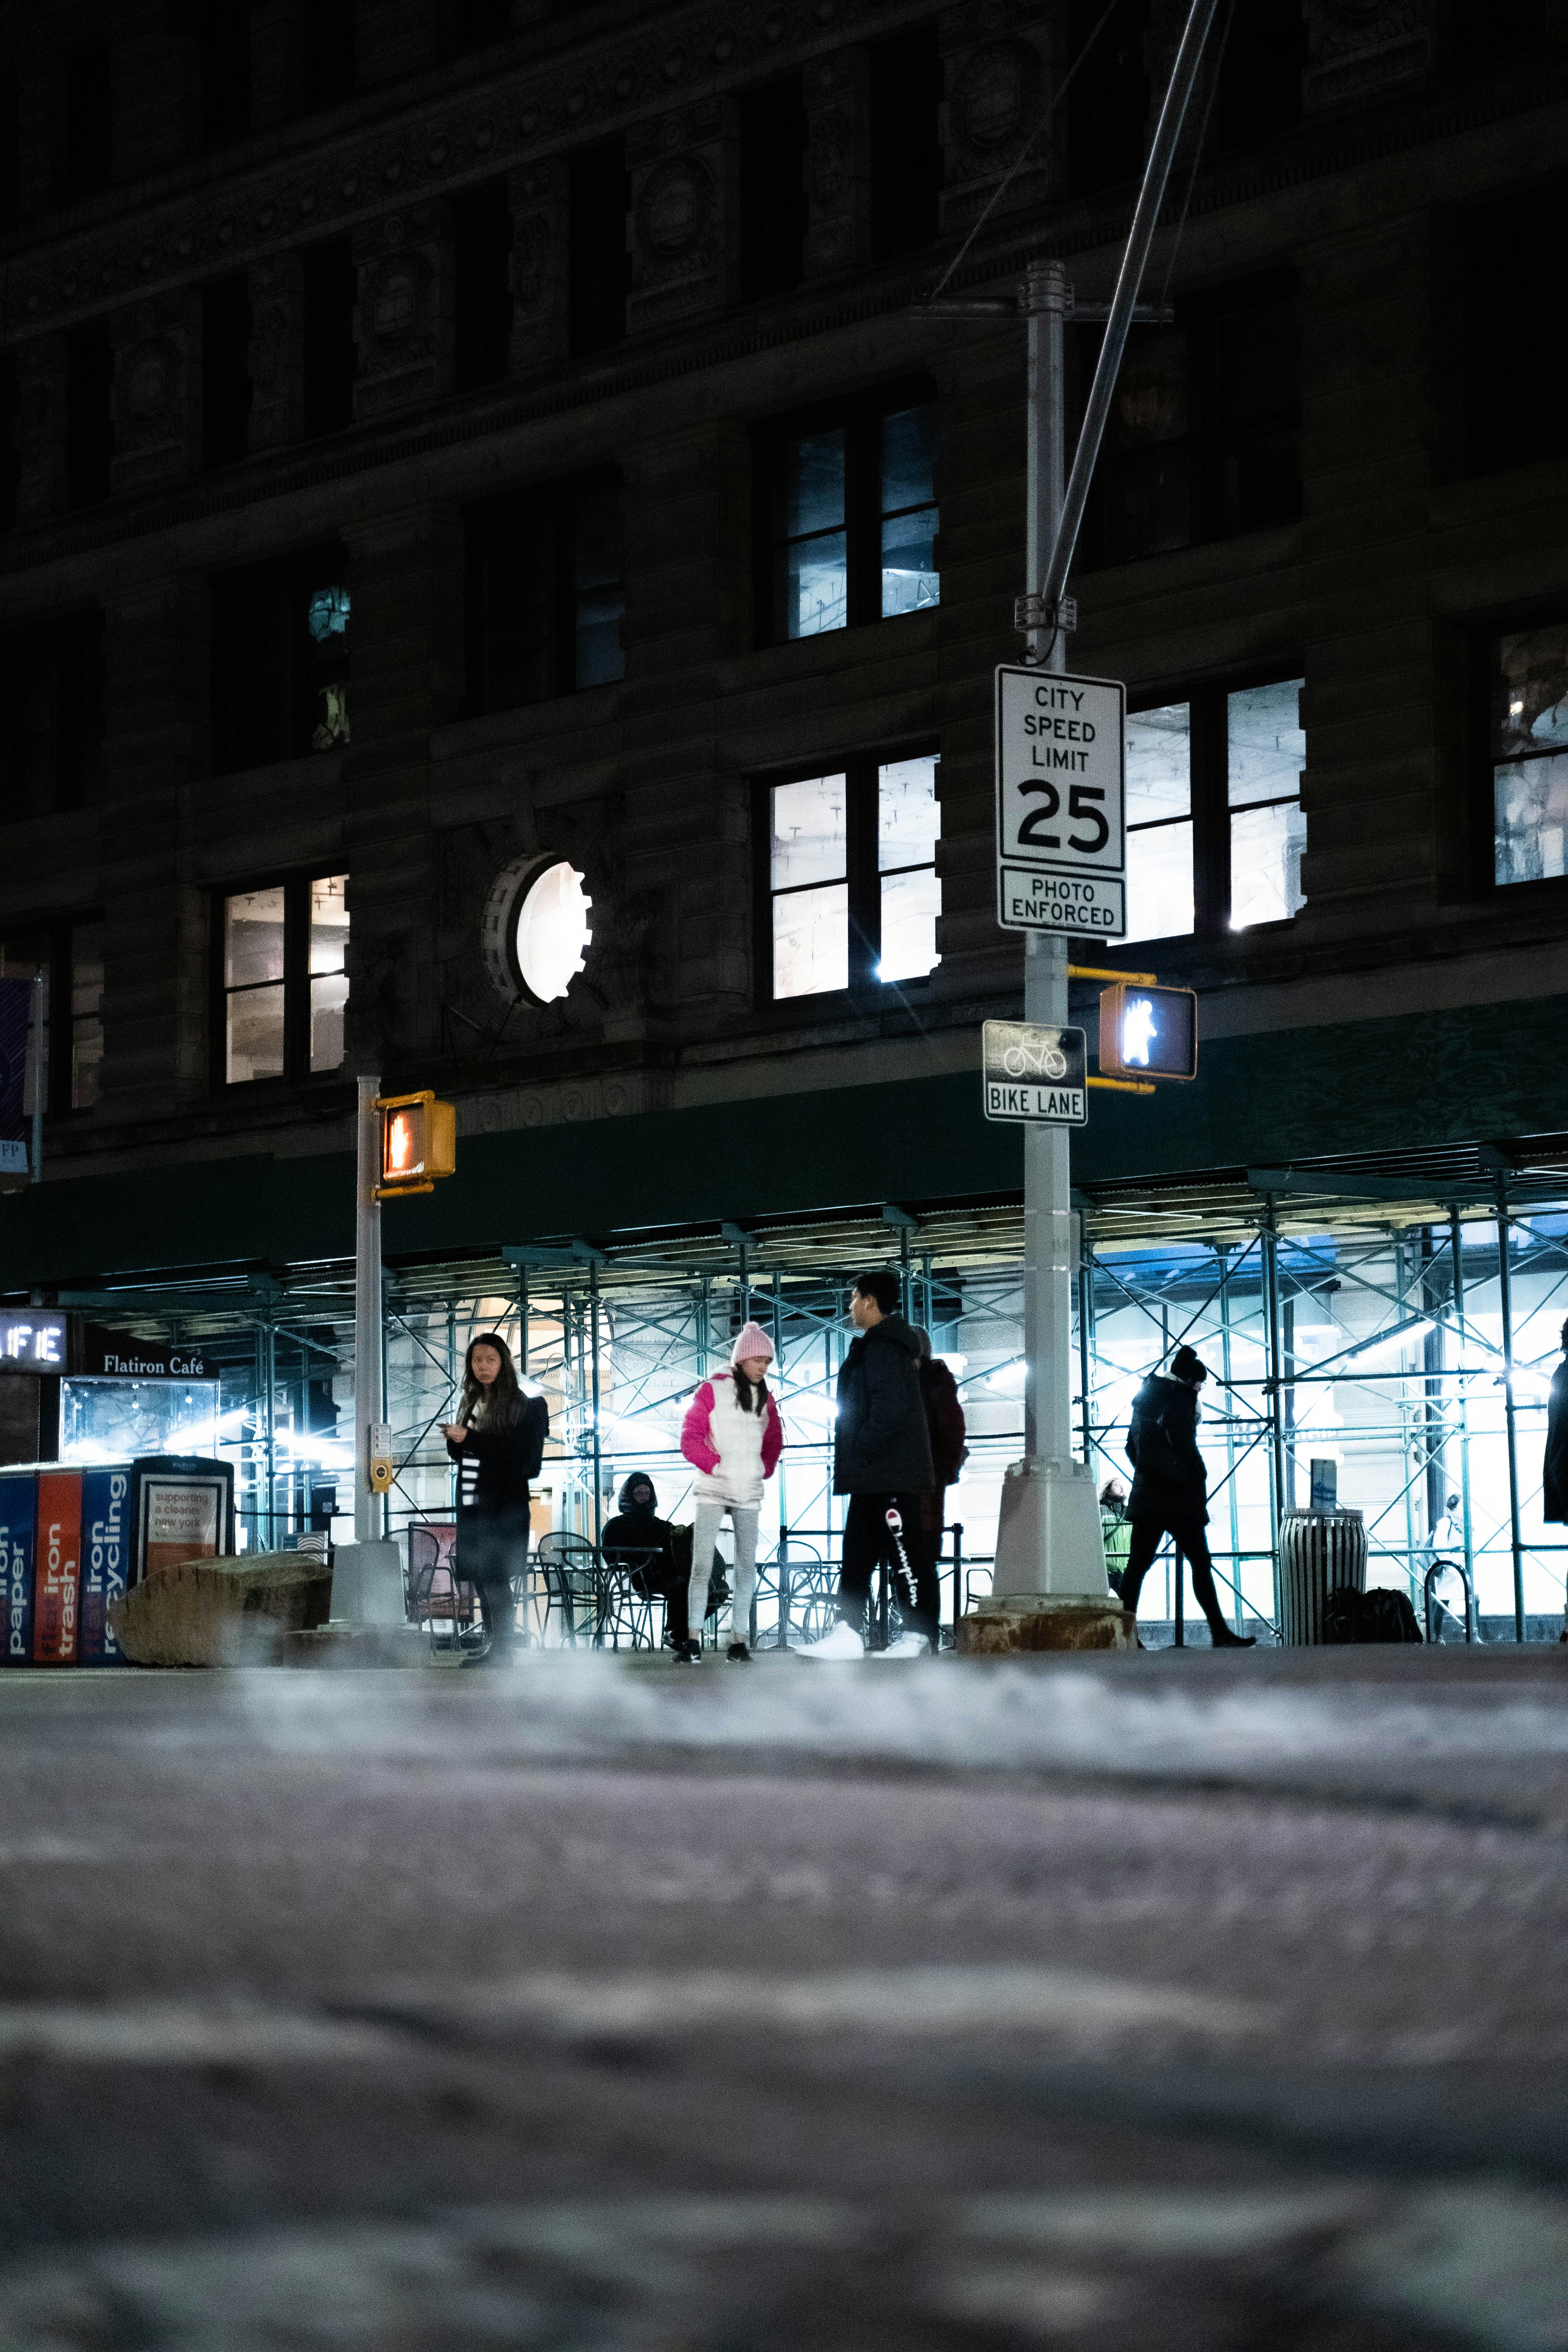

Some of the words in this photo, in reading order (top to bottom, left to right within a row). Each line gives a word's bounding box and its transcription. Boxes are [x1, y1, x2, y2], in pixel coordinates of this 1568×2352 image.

[1035, 685, 1085, 711] CITY
[1024, 715, 1096, 743] SPEED
[1033, 745, 1089, 772] LIMIT
[1017, 779, 1109, 853] 25
[1032, 879, 1095, 903] PHOTO
[1012, 898, 1115, 926] ENFORCED
[991, 1087, 1029, 1112] BIKE
[1038, 1091, 1082, 1116] LANE
[104, 1355, 165, 1374] Flatiron
[170, 1357, 203, 1374] Café
[885, 1508, 918, 1607] Champion
[10, 1541, 27, 1655] paper
[58, 1560, 75, 1657] trash
